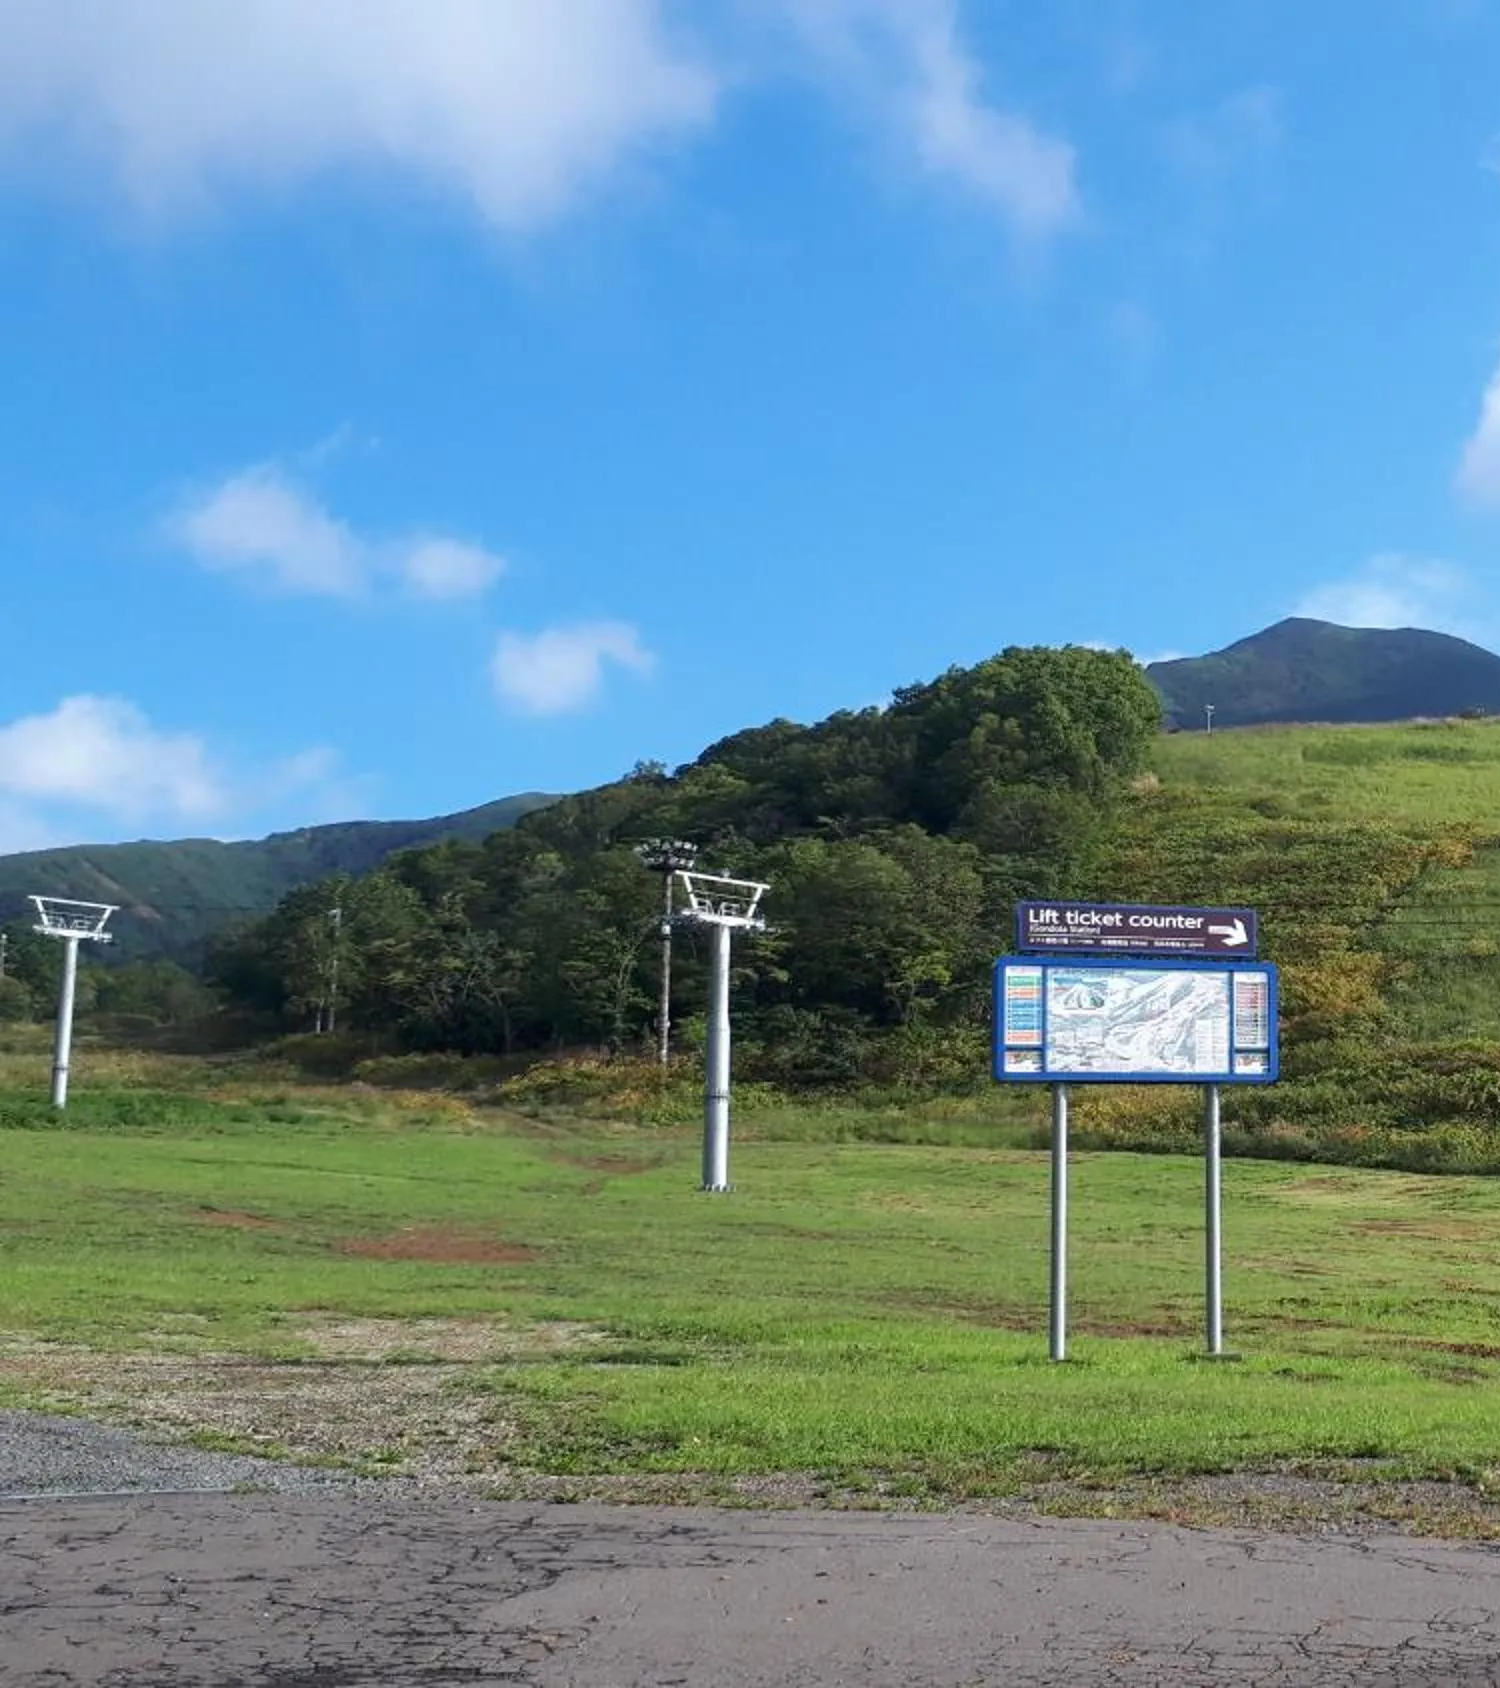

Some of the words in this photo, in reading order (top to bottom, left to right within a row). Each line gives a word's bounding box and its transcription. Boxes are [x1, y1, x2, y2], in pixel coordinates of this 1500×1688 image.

[1029, 908, 1059, 924] Lift
[1066, 910, 1123, 926] ticket
[1129, 915, 1205, 929] counter
